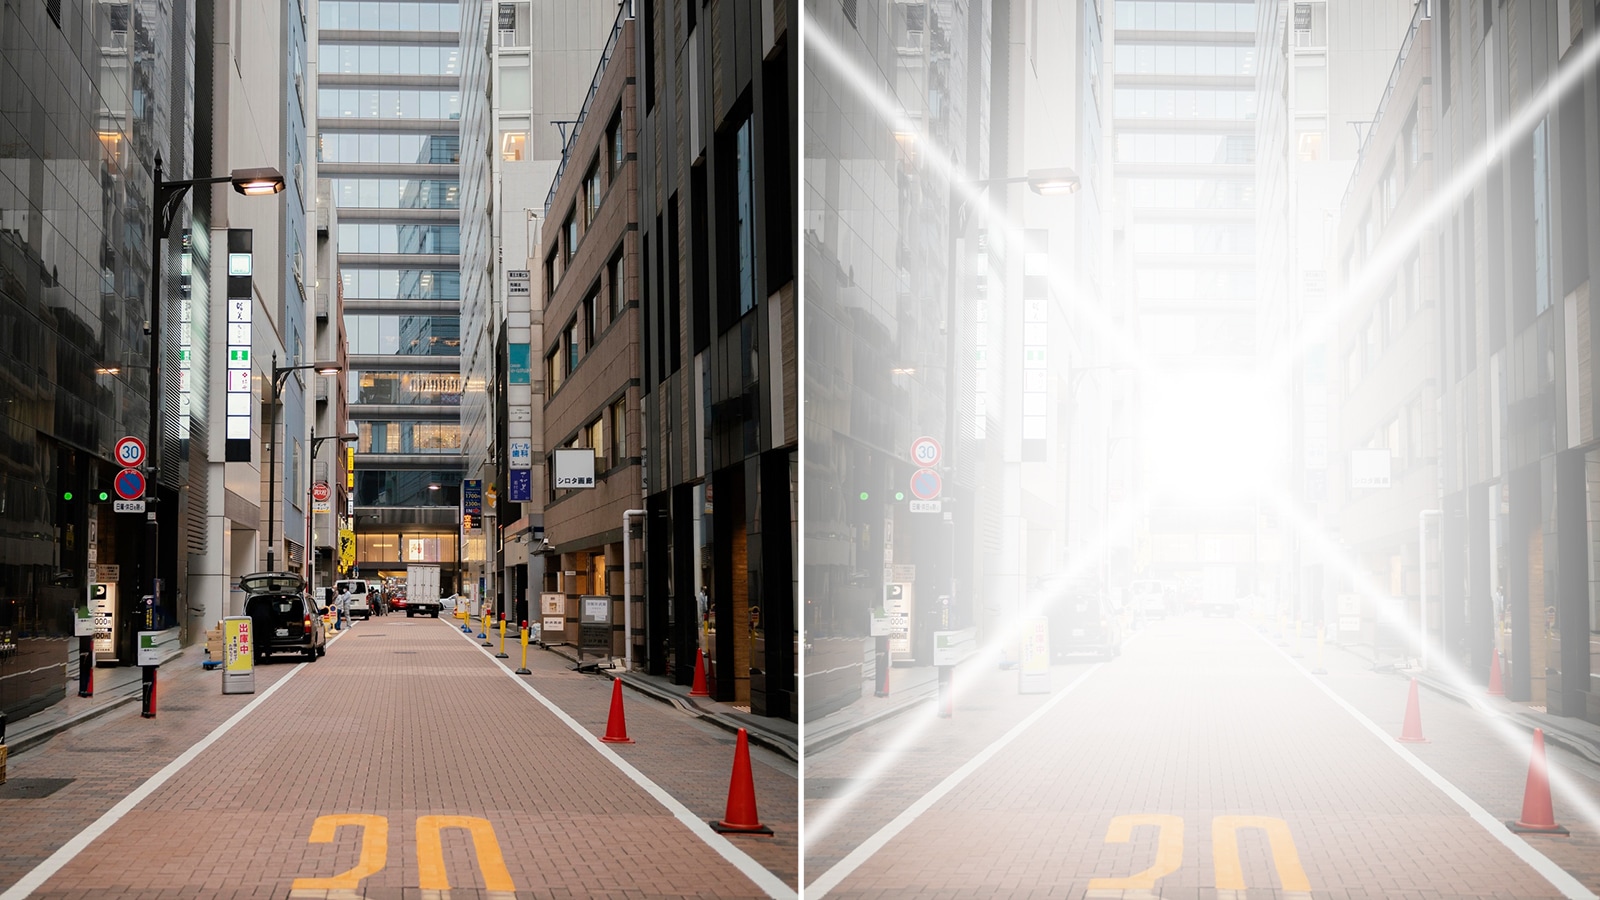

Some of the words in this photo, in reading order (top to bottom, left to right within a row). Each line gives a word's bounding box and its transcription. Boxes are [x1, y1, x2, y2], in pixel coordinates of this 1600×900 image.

[122, 445, 139, 459] 30
[512, 450, 529, 458] 歯科
[918, 445, 935, 459] 30
[240, 623, 249, 654] 出庫中
